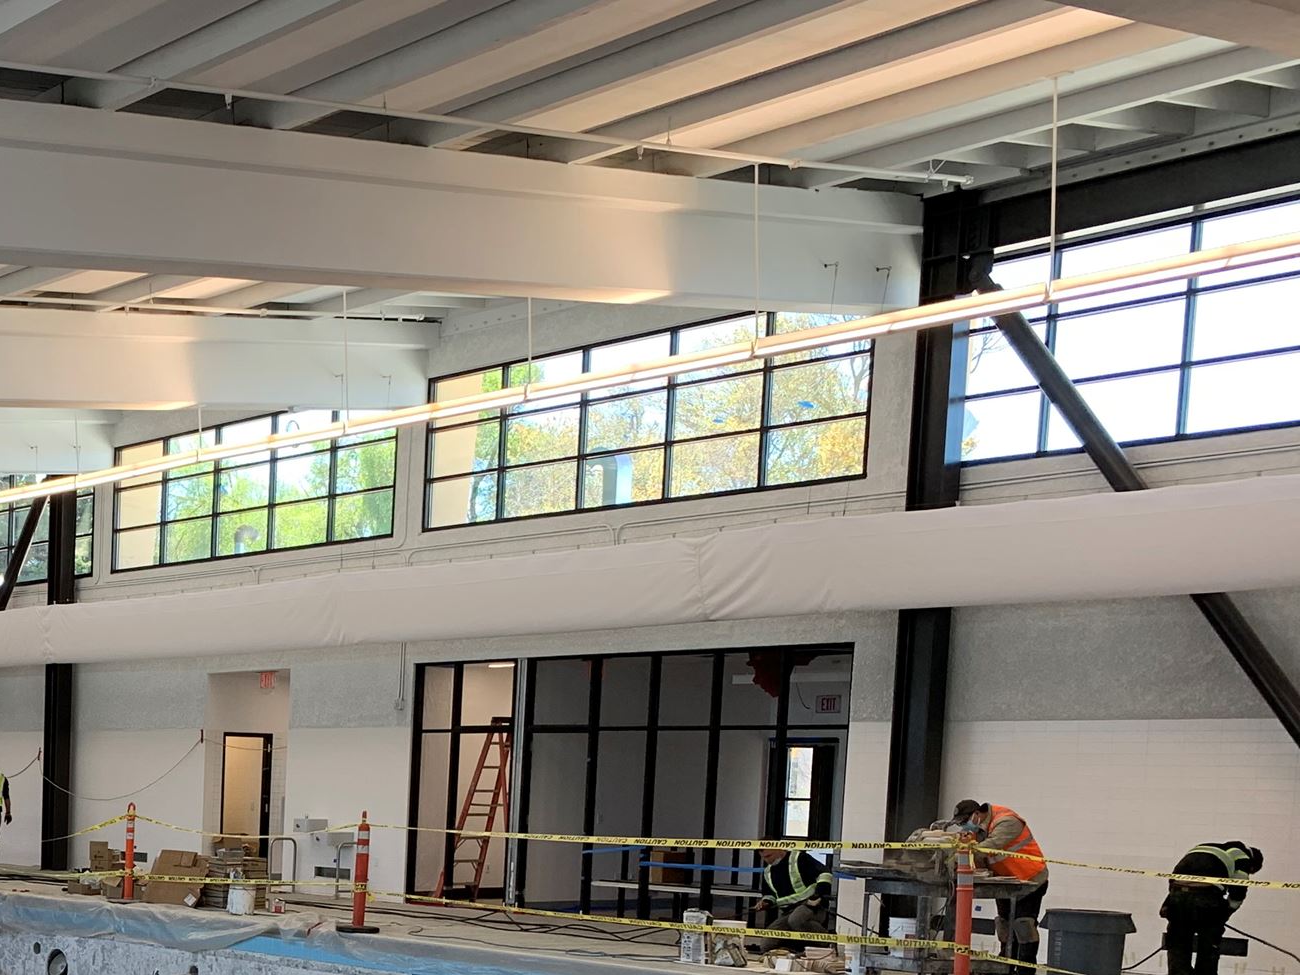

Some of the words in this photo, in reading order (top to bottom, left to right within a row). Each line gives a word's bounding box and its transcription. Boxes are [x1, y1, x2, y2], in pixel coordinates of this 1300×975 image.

[821, 697, 836, 711] EXIT
[715, 840, 752, 848] CAUTION
[758, 841, 797, 849] CAUTION
[804, 842, 843, 850] CAUTION
[1155, 872, 1207, 882] CAUTION
[1219, 877, 1271, 888] CAUTION
